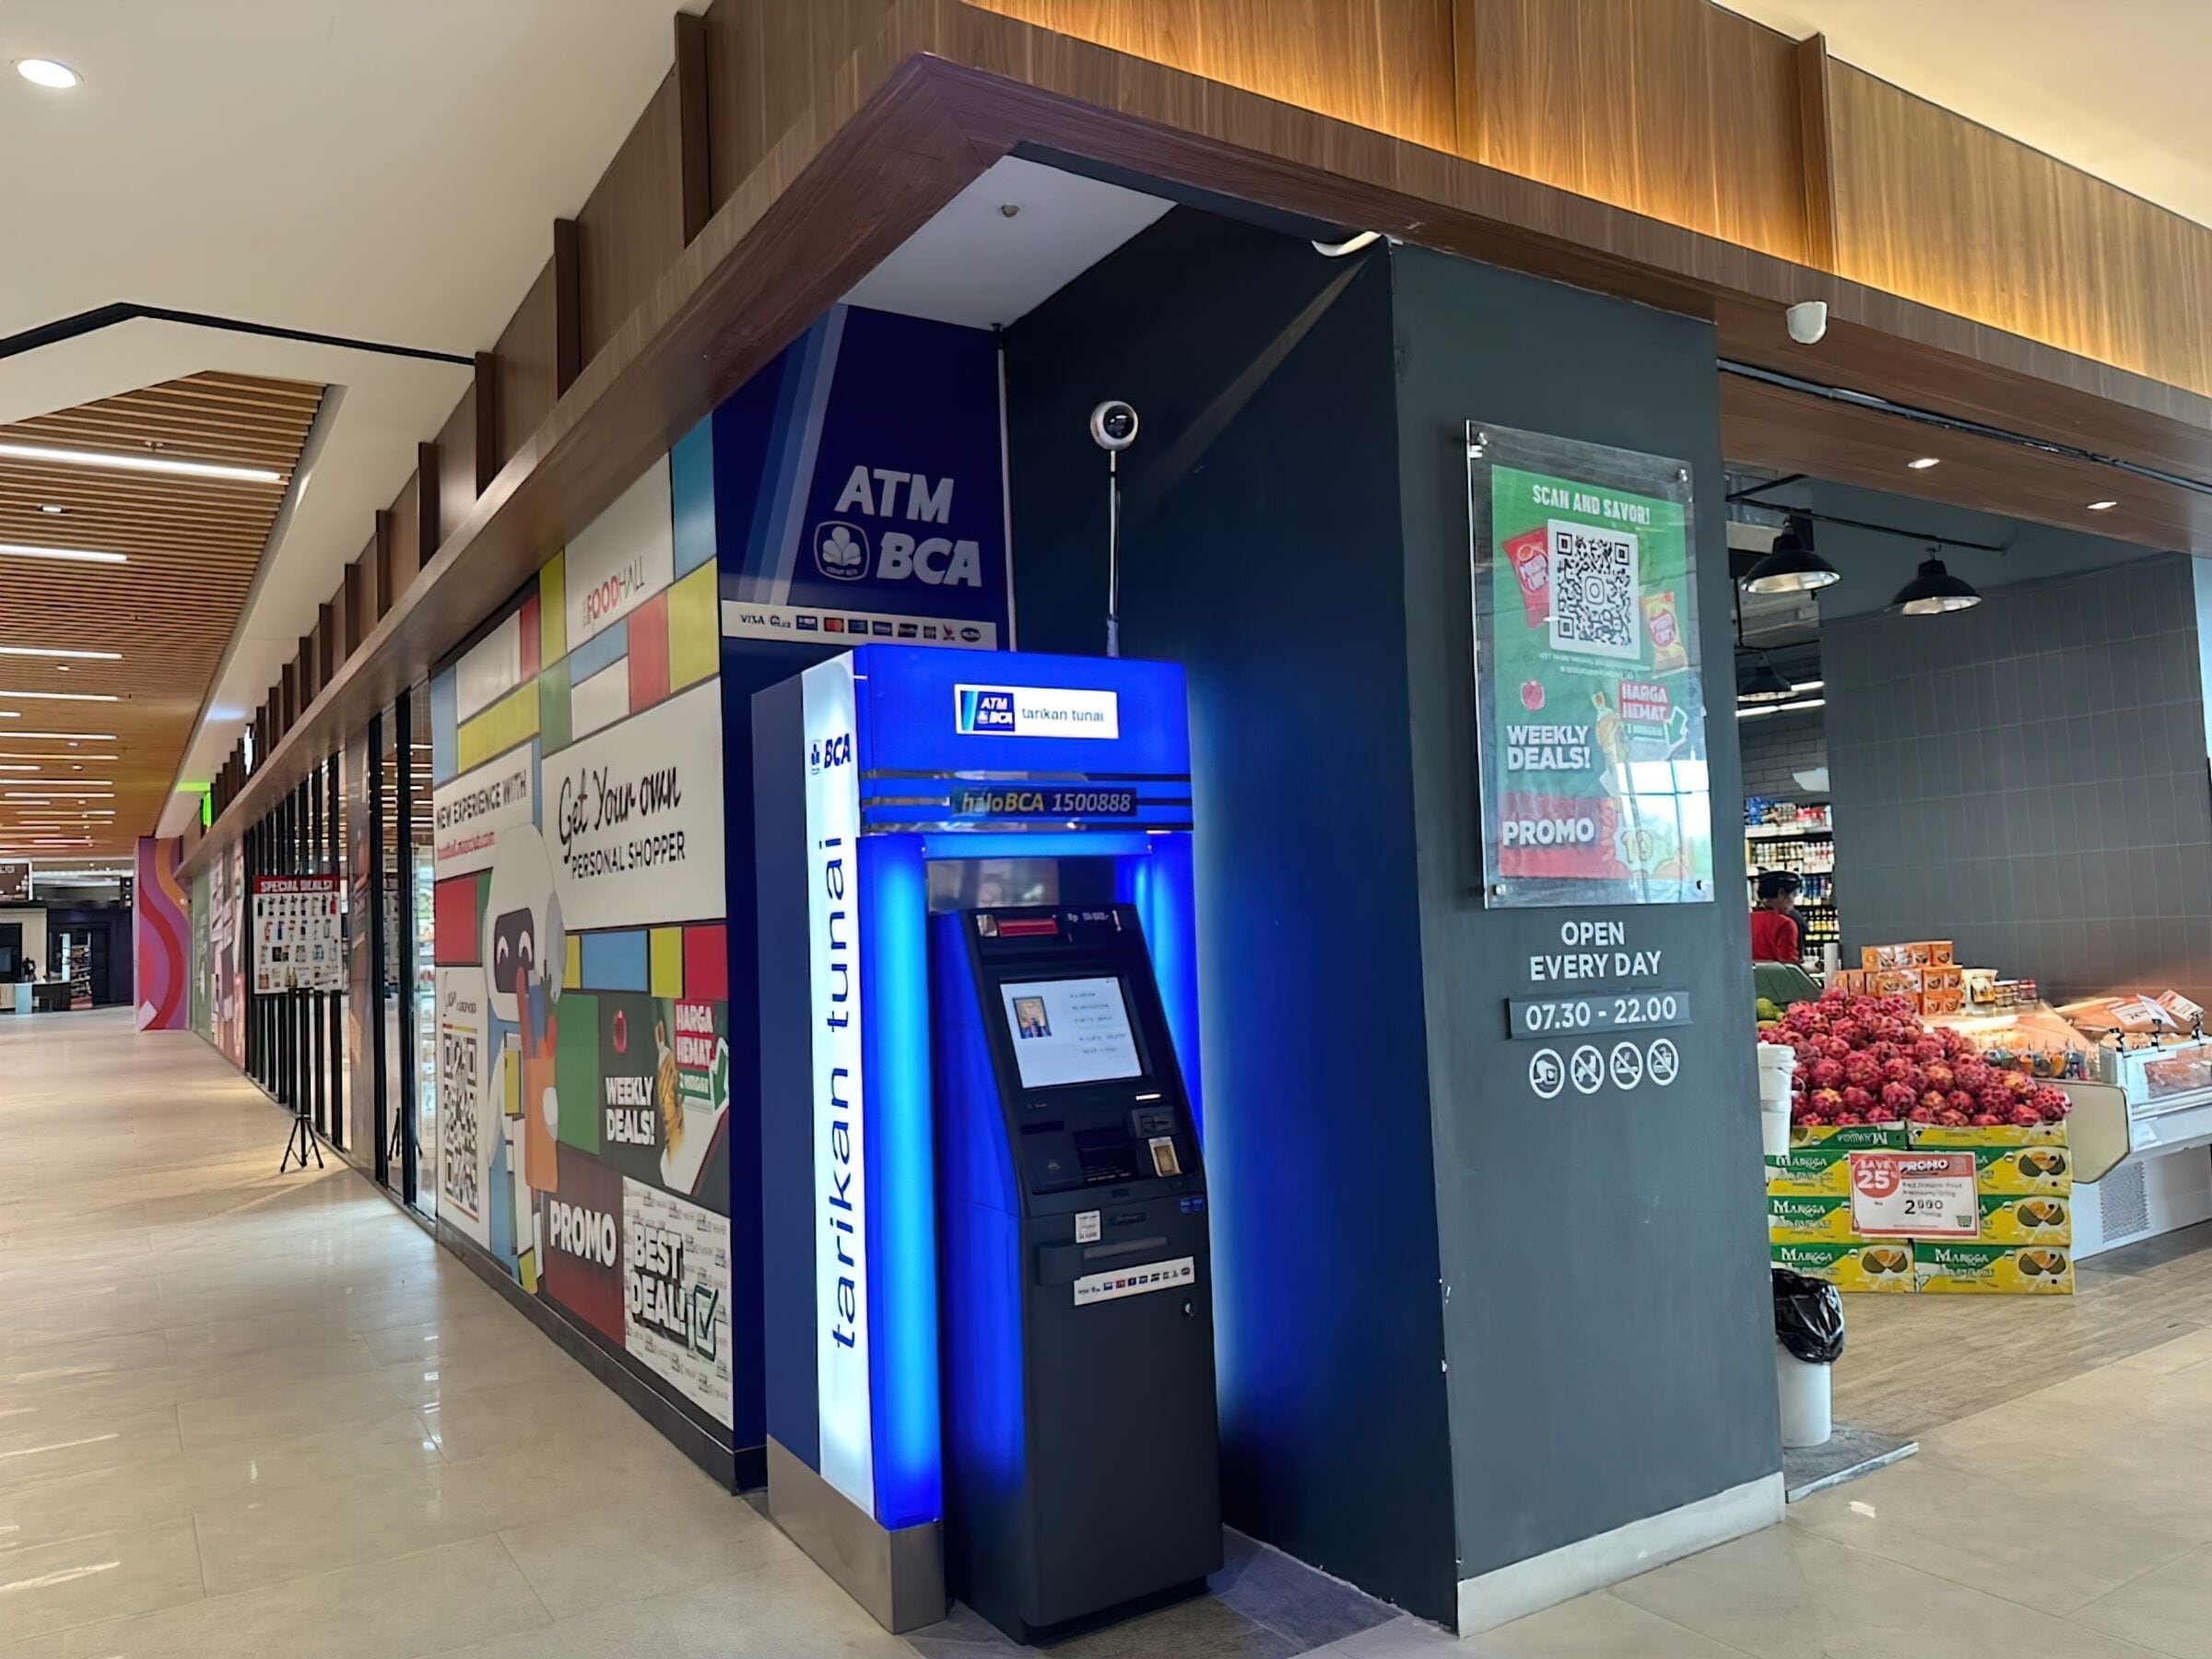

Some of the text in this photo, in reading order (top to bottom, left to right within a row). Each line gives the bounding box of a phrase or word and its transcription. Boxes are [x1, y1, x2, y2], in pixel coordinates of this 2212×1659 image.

[834, 465, 954, 524] ATM
[1533, 485, 1651, 525] SCAN AND SAVOR!
[876, 532, 982, 587] BCA
[981, 698, 1007, 710] ATM
[1622, 683, 1668, 703] HARGA
[1022, 708, 1104, 722] tarikan tunai
[1507, 725, 1589, 745] WEEKLY
[824, 733, 851, 769] BCA
[1508, 747, 1591, 771] DEALS!
[559, 767, 588, 865] Get
[593, 766, 636, 831] Your
[640, 766, 681, 817] own
[961, 792, 1131, 813] haloBCA 1500888
[1502, 818, 1594, 846] PROMO
[571, 830, 685, 880] PERSONAL SHOPPER
[1561, 922, 1625, 946] OPEN
[1530, 951, 1662, 981] EVERY DAY
[676, 1005, 714, 1033] HARGA
[1525, 1002, 1591, 1030] 07.30
[1614, 996, 1677, 1024] 22.00
[677, 1037, 712, 1066] HEMAT
[606, 1077, 653, 1106] WEEKLY
[819, 834, 856, 1349] tarikan tunai
[606, 1109, 655, 1146] DEALS!
[1900, 1159, 1949, 1172] PROMO
[550, 1200, 617, 1267] PROMO
[633, 1223, 683, 1282] BEST
[631, 1271, 687, 1335] DEAL!
